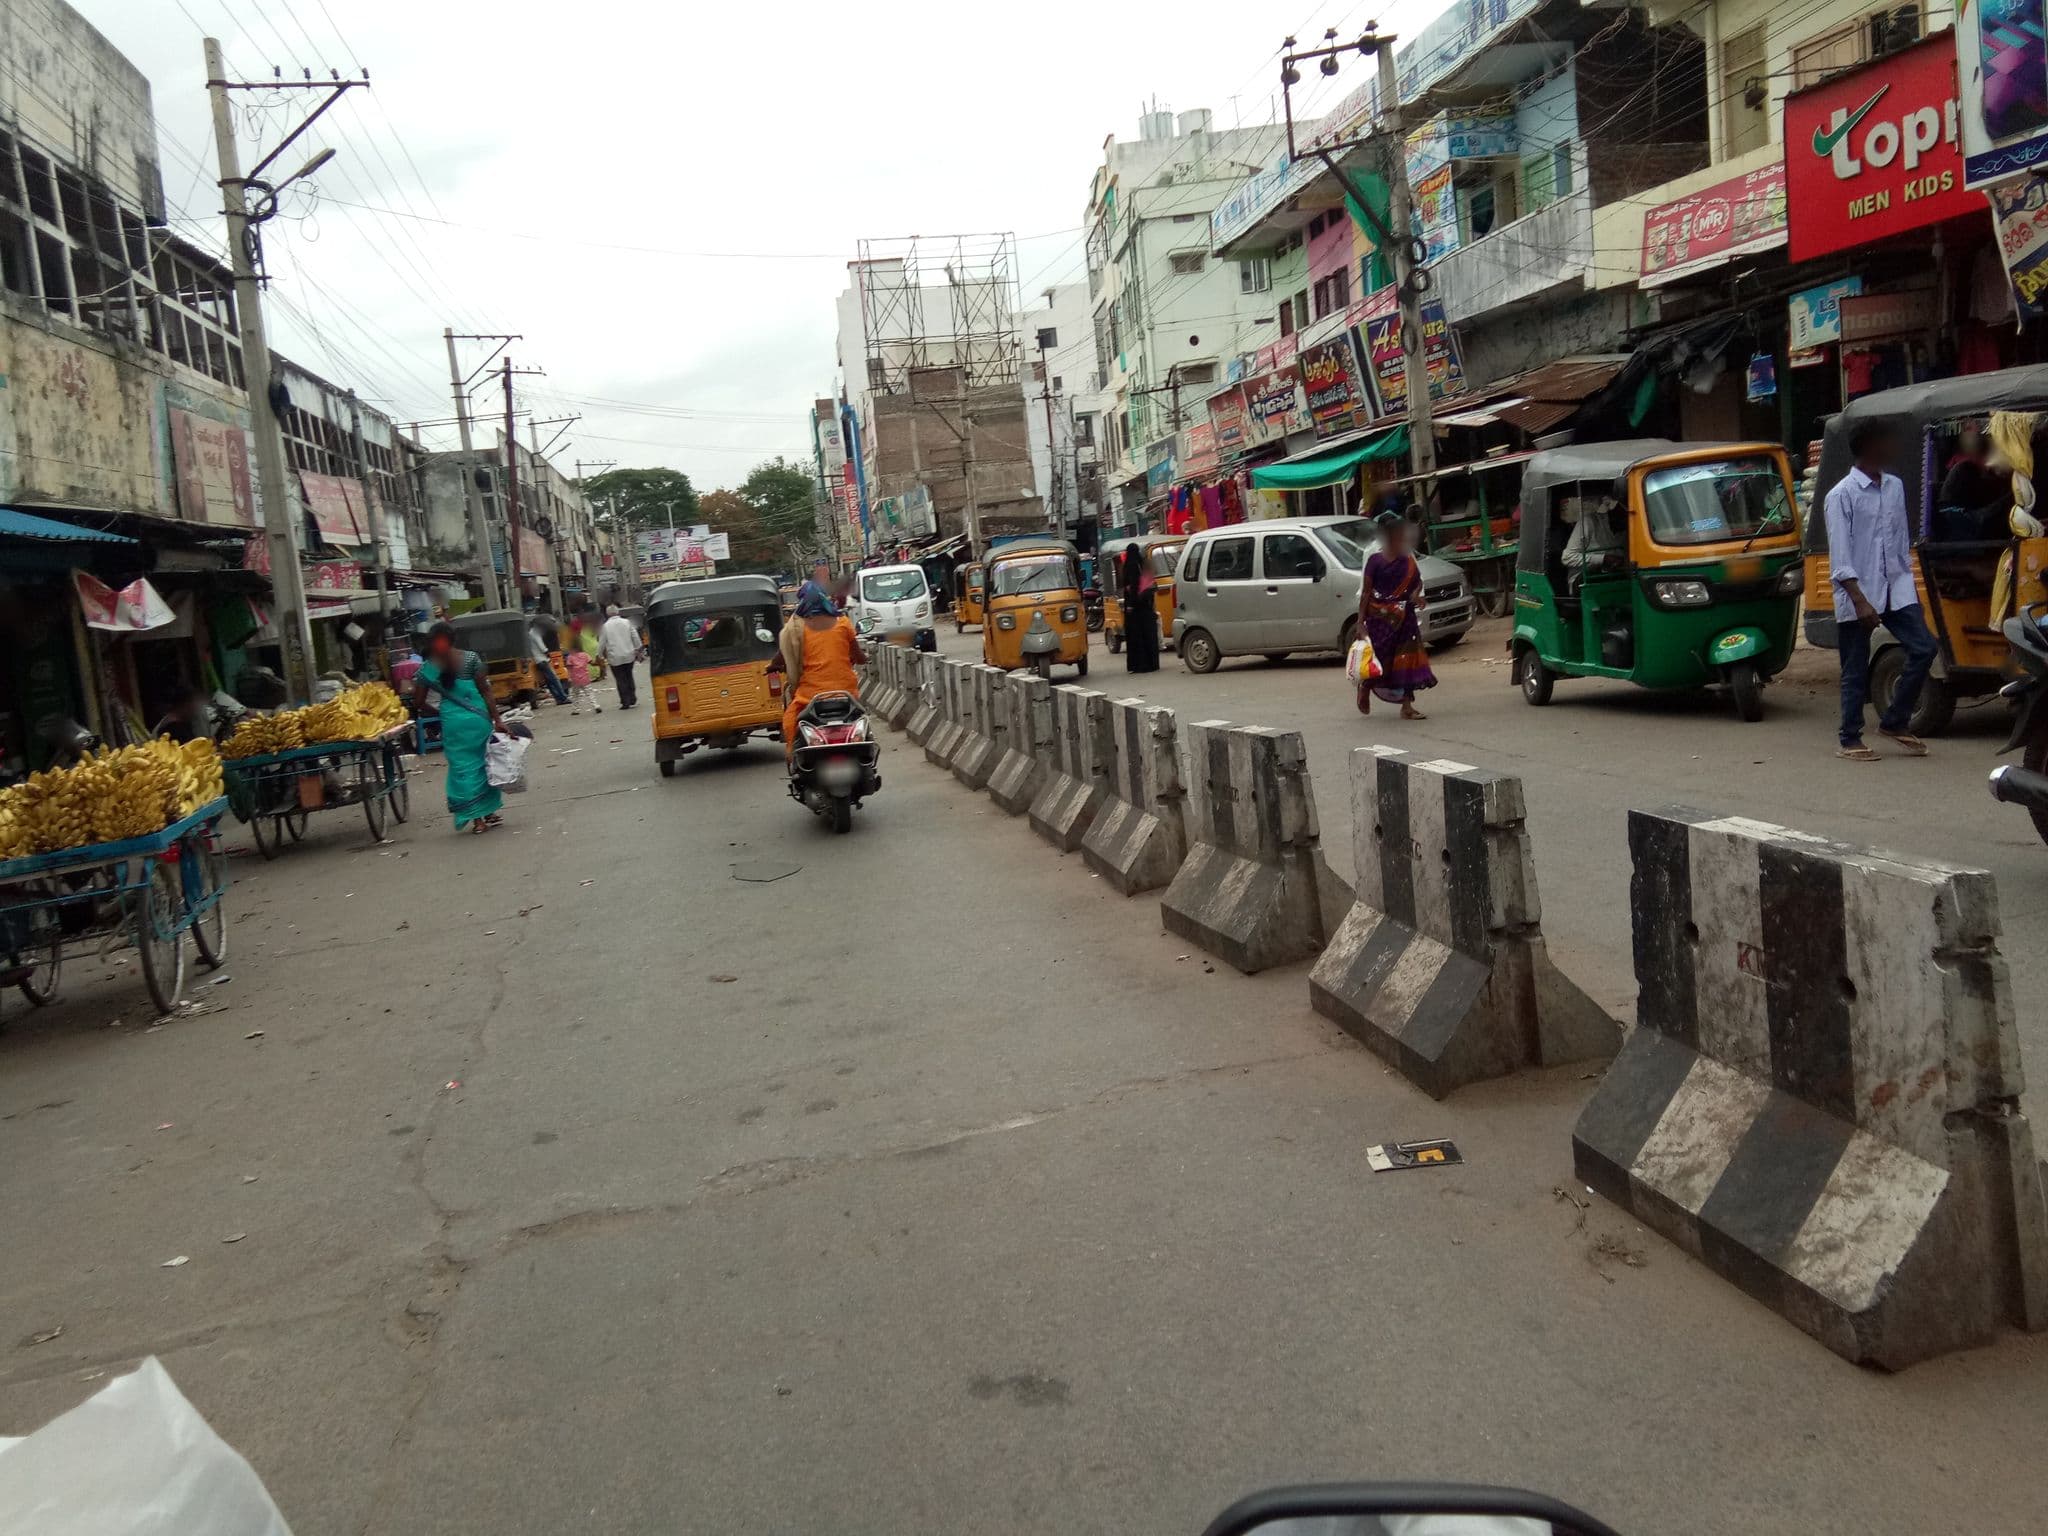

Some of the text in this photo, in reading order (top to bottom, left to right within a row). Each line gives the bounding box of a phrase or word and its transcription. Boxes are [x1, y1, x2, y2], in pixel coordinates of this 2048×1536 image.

[1848, 169, 1954, 220] MEN KIDS
[1698, 207, 1724, 231] MTR
